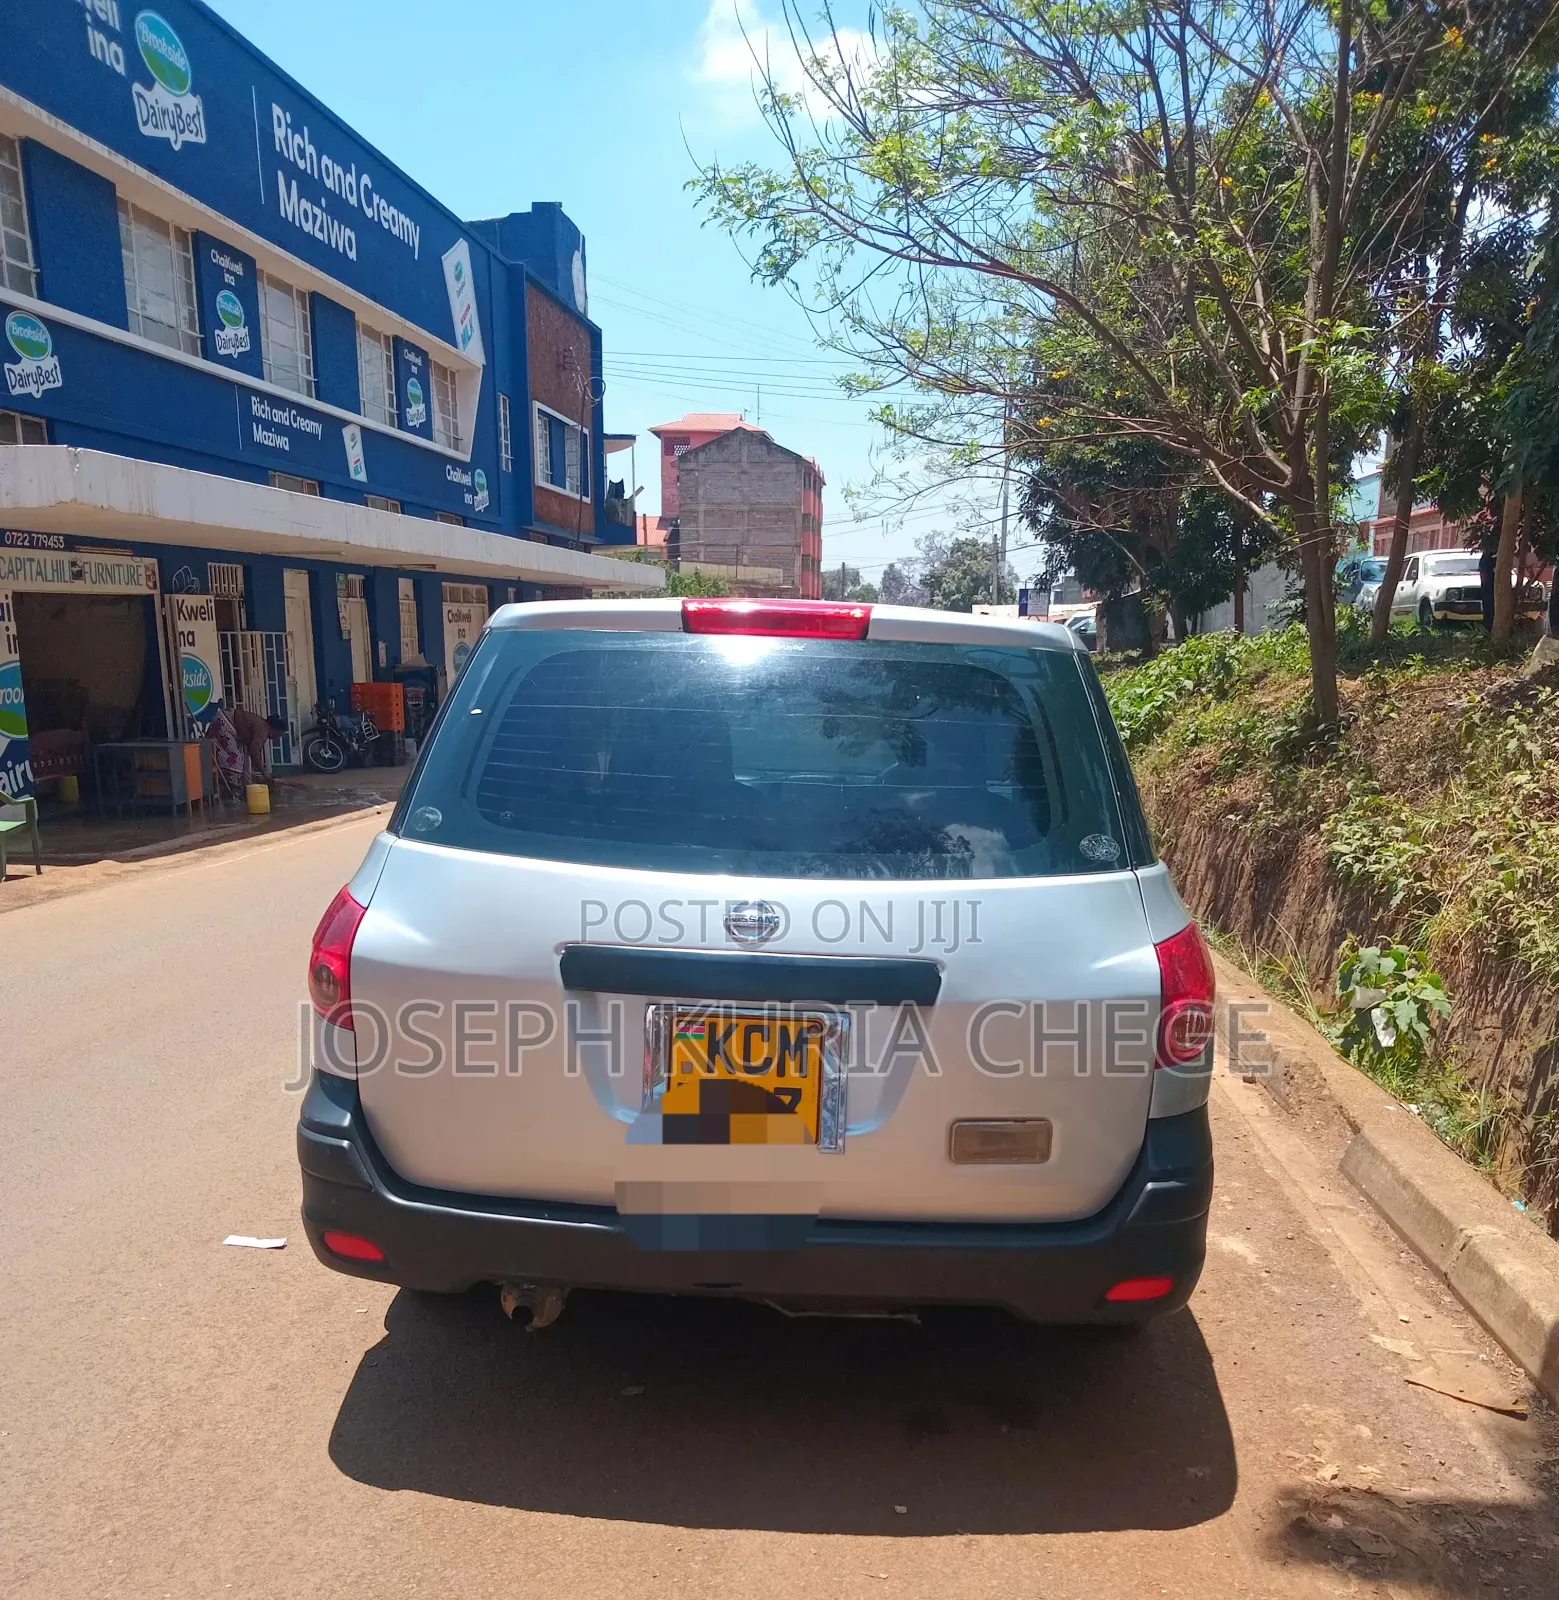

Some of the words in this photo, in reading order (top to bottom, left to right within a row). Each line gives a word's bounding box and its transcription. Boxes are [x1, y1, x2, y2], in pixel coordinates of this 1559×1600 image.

[86, 12, 125, 76] ina
[139, 22, 187, 71] Brookside
[135, 92, 204, 145] DairyBest
[272, 103, 318, 179] Rich
[321, 155, 357, 207] and
[360, 174, 420, 260] Creamy
[278, 170, 357, 261] Maziwa
[224, 269, 236, 286] ina
[10, 321, 48, 343] Brookside
[217, 333, 249, 352] DairyBest
[6, 363, 60, 394] DairyBest
[251, 395, 271, 420] Rich
[272, 408, 289, 426] and
[290, 410, 322, 440] Creamy
[252, 422, 289, 451] Maziwa
[5, 531, 30, 546] 0722
[31, 533, 65, 549] 779453
[82, 561, 144, 587] FURNITURE
[176, 598, 214, 622] Kweli
[729, 914, 773, 924] NISSAN
[706, 1021, 809, 1079] KCM
